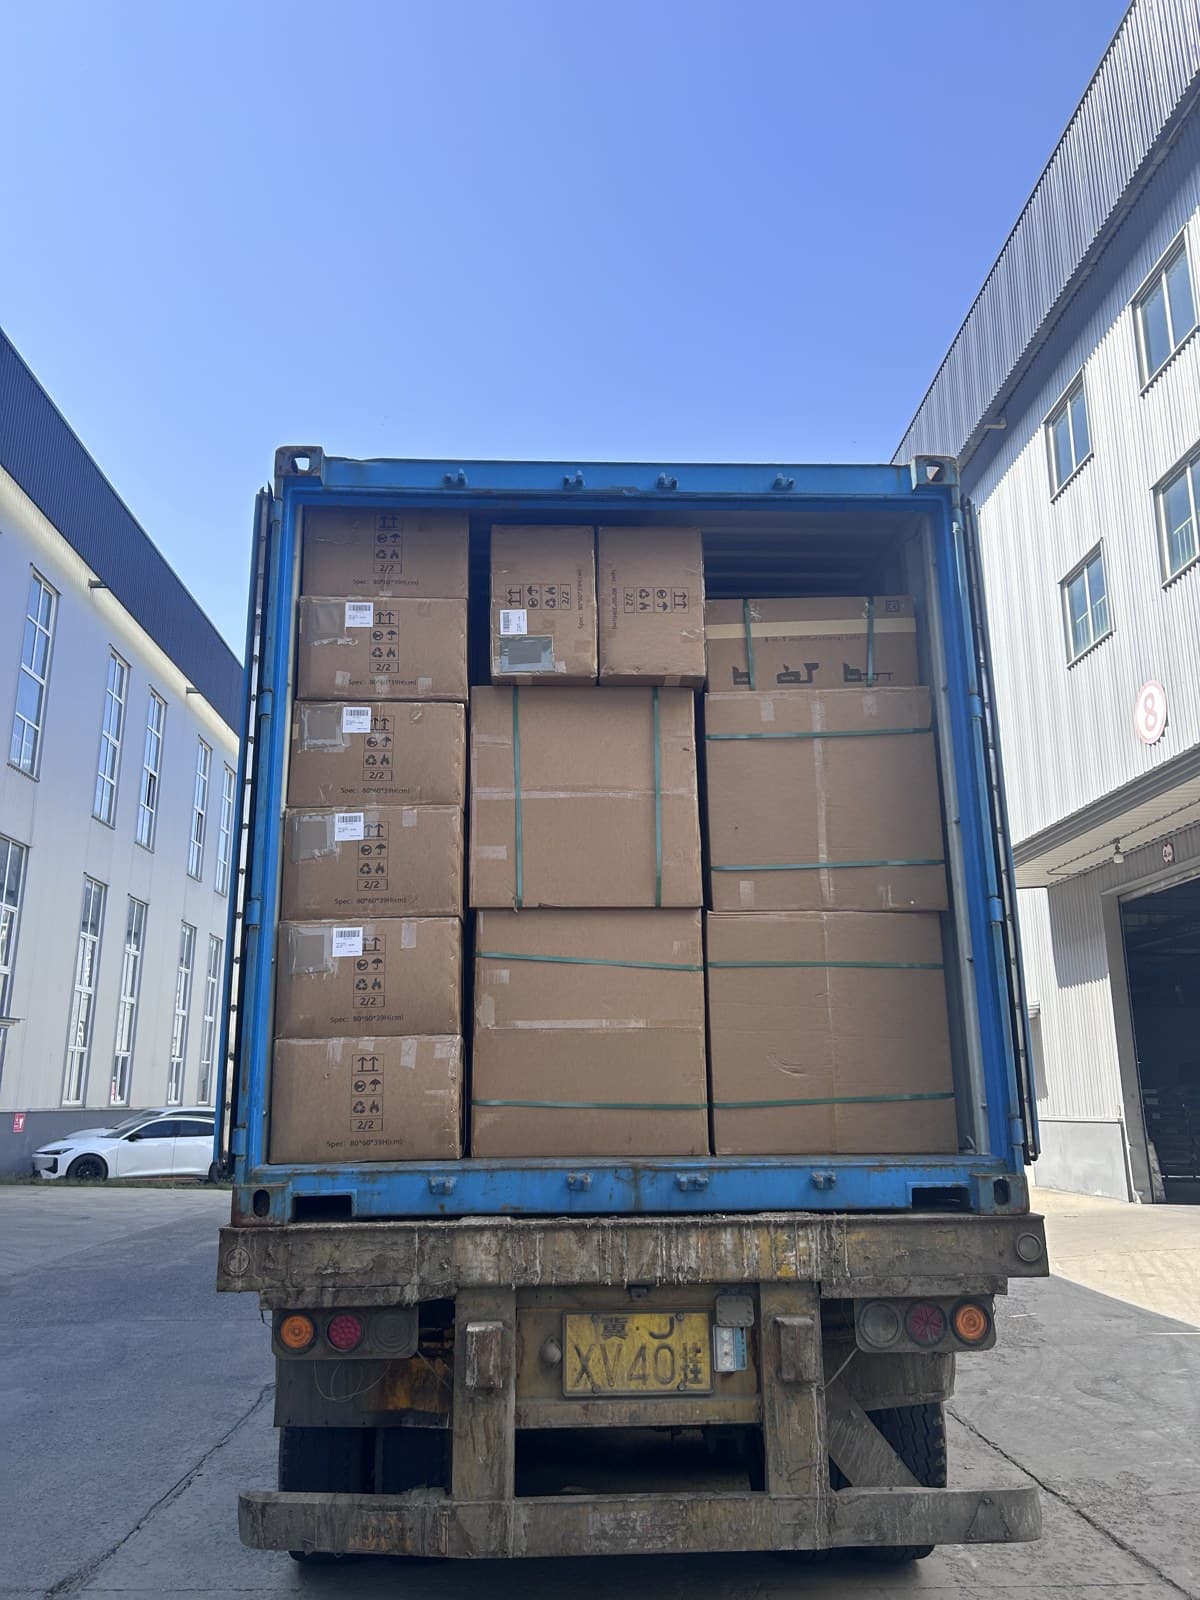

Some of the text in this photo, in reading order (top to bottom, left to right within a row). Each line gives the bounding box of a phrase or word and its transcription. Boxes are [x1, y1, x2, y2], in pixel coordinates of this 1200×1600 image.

[379, 564, 395, 573] 2/2
[561, 591, 570, 605] 2/2
[626, 592, 634, 606] 2/2
[376, 663, 391, 672] 2/2
[1142, 692, 1159, 732] 8
[368, 771, 385, 780] 2/2
[363, 880, 380, 890] 2/2
[360, 996, 377, 1006] 2/2
[357, 1120, 374, 1130] 2/2
